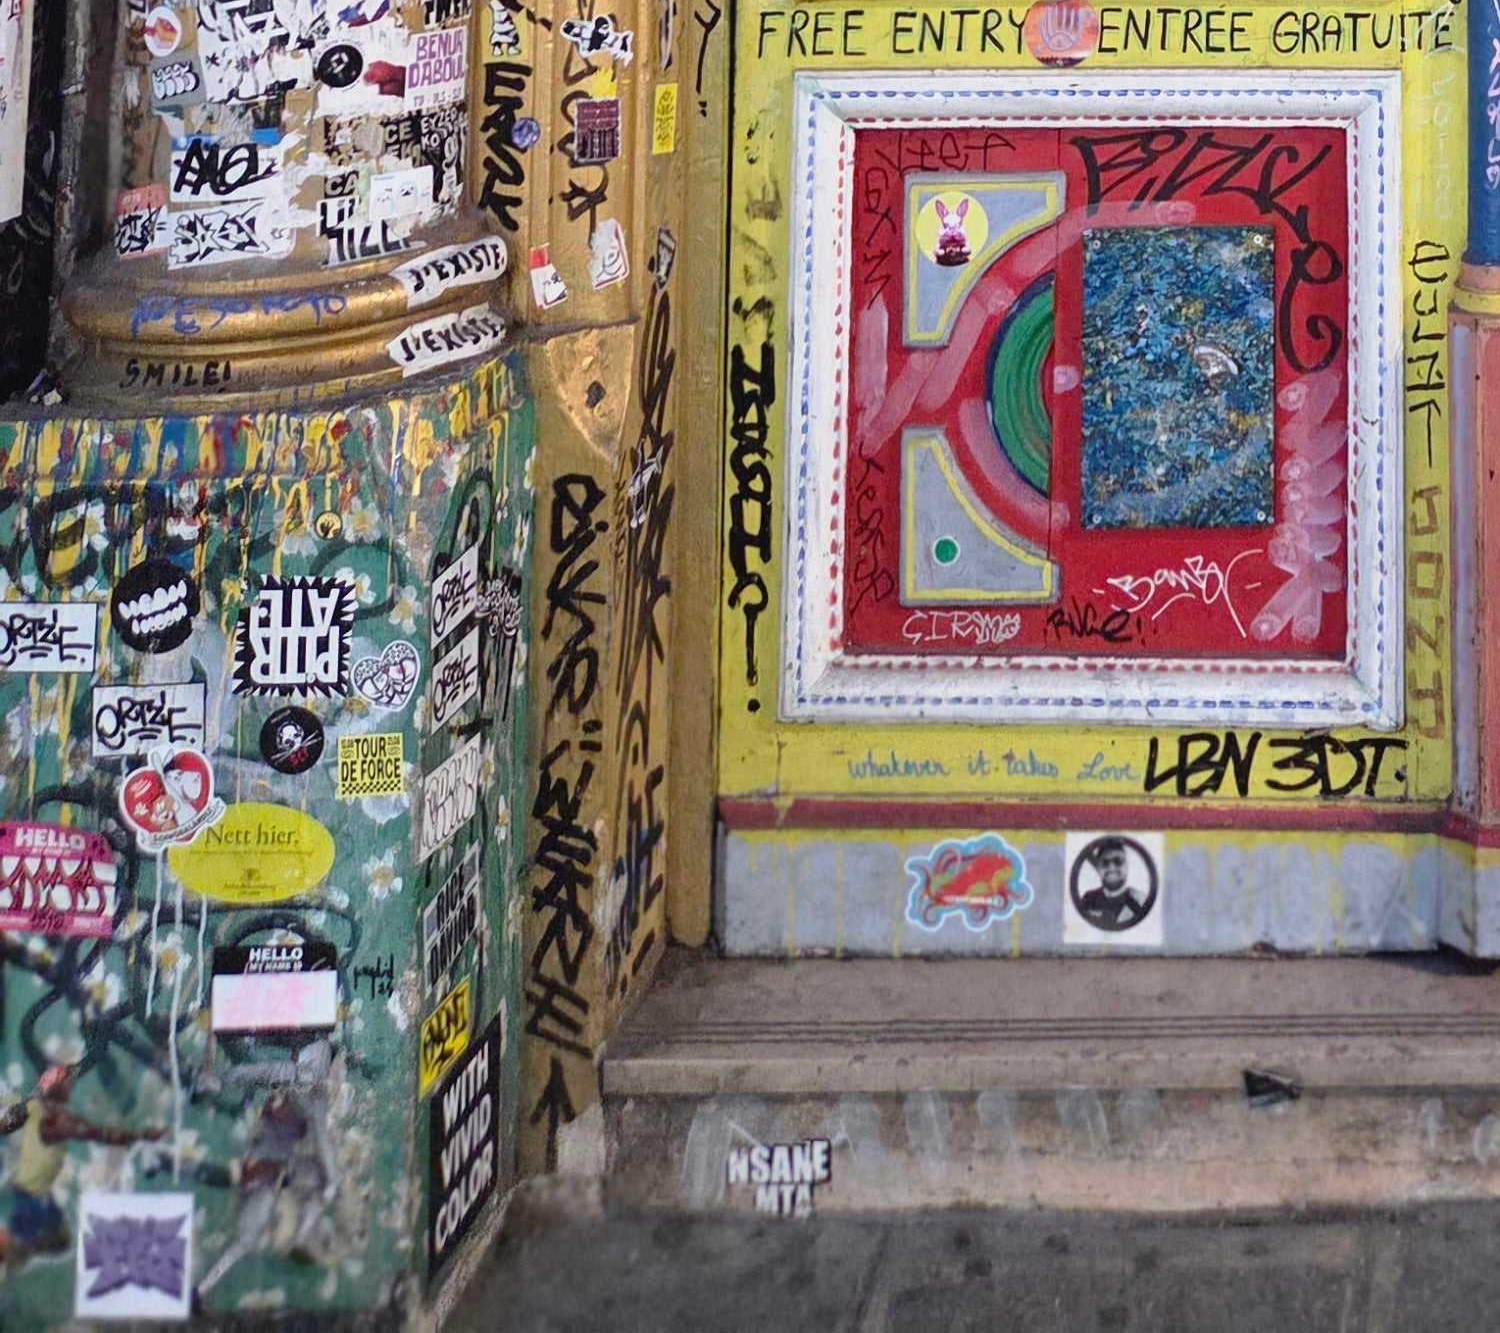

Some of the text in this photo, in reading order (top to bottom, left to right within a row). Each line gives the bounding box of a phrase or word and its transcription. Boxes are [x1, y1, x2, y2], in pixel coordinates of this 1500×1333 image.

[758, 9, 866, 58] FREE
[892, 5, 1028, 54] ENTRY
[1273, 8, 1456, 55] GRATUITE
[412, 241, 507, 294] J'EXISTE.
[119, 359, 231, 391] SMILE!
[354, 737, 387, 759] TOUR
[341, 758, 401, 782] DE FORCE
[15, 827, 86, 851] HELLO
[205, 824, 252, 846] Nett
[256, 822, 300, 846] hier.
[249, 947, 304, 962] HELLO
[443, 1040, 489, 1130] WITH
[442, 1093, 493, 1187] VIVID
[436, 1140, 495, 1251] COLOR
